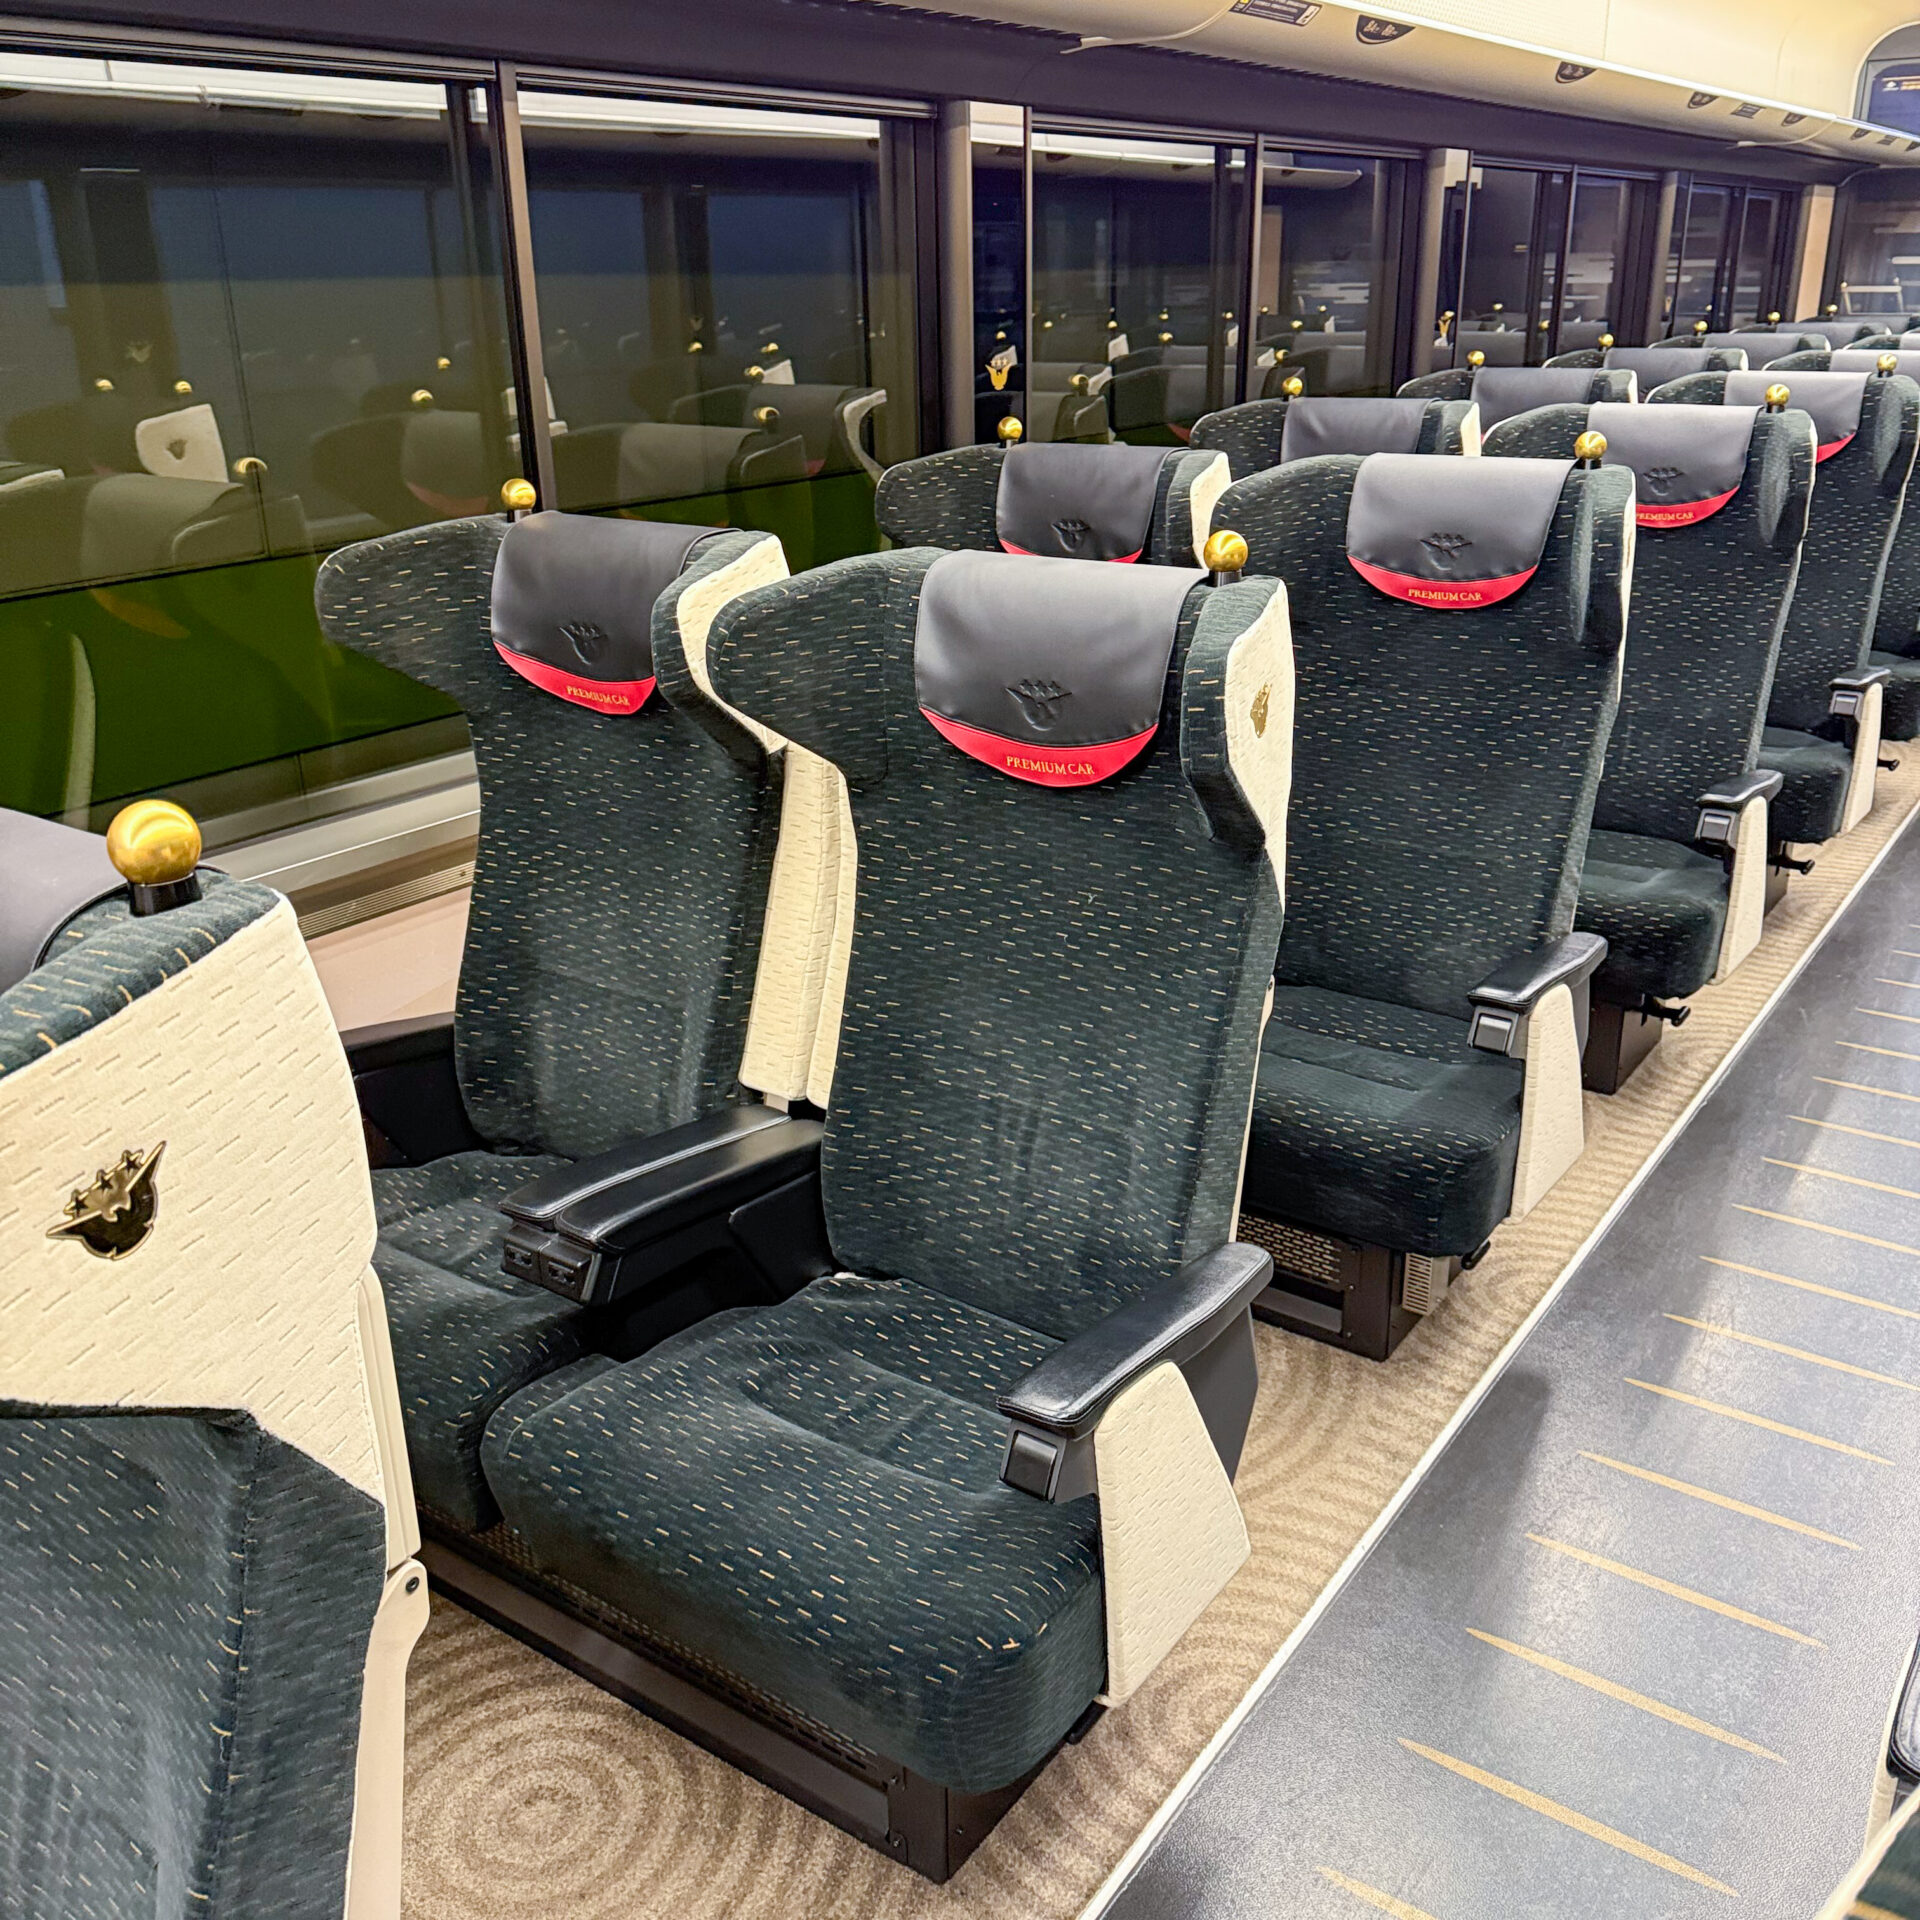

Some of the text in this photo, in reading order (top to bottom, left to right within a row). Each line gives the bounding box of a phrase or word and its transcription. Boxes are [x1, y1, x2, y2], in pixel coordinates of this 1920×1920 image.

[1676, 511, 1694, 520] CAR
[1408, 589, 1482, 601] PREMIUM CAR
[566, 685, 630, 706] PREMIUM CAR
[1006, 755, 1095, 775] PREMIUM CAR
